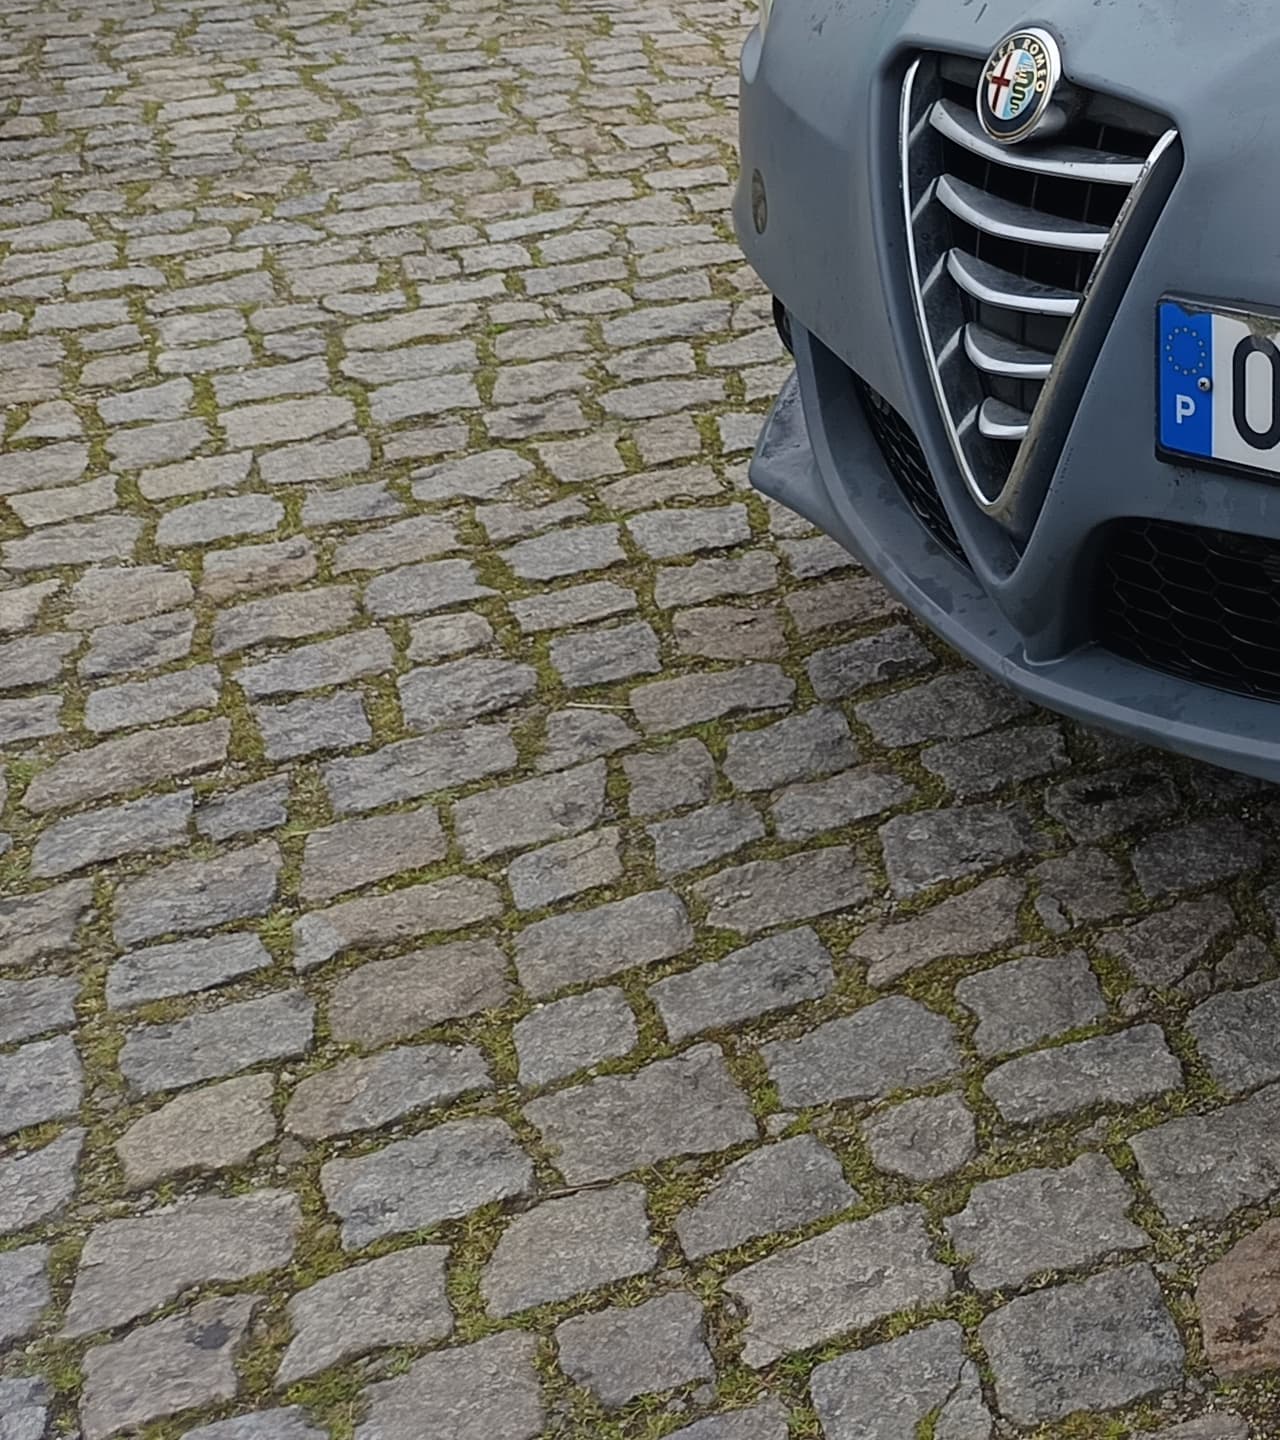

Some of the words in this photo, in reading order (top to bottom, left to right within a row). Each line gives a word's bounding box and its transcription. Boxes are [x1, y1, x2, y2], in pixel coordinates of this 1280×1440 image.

[986, 40, 1016, 82] ALFA
[1022, 38, 1048, 92] ROMEO
[1175, 394, 1196, 424] P
